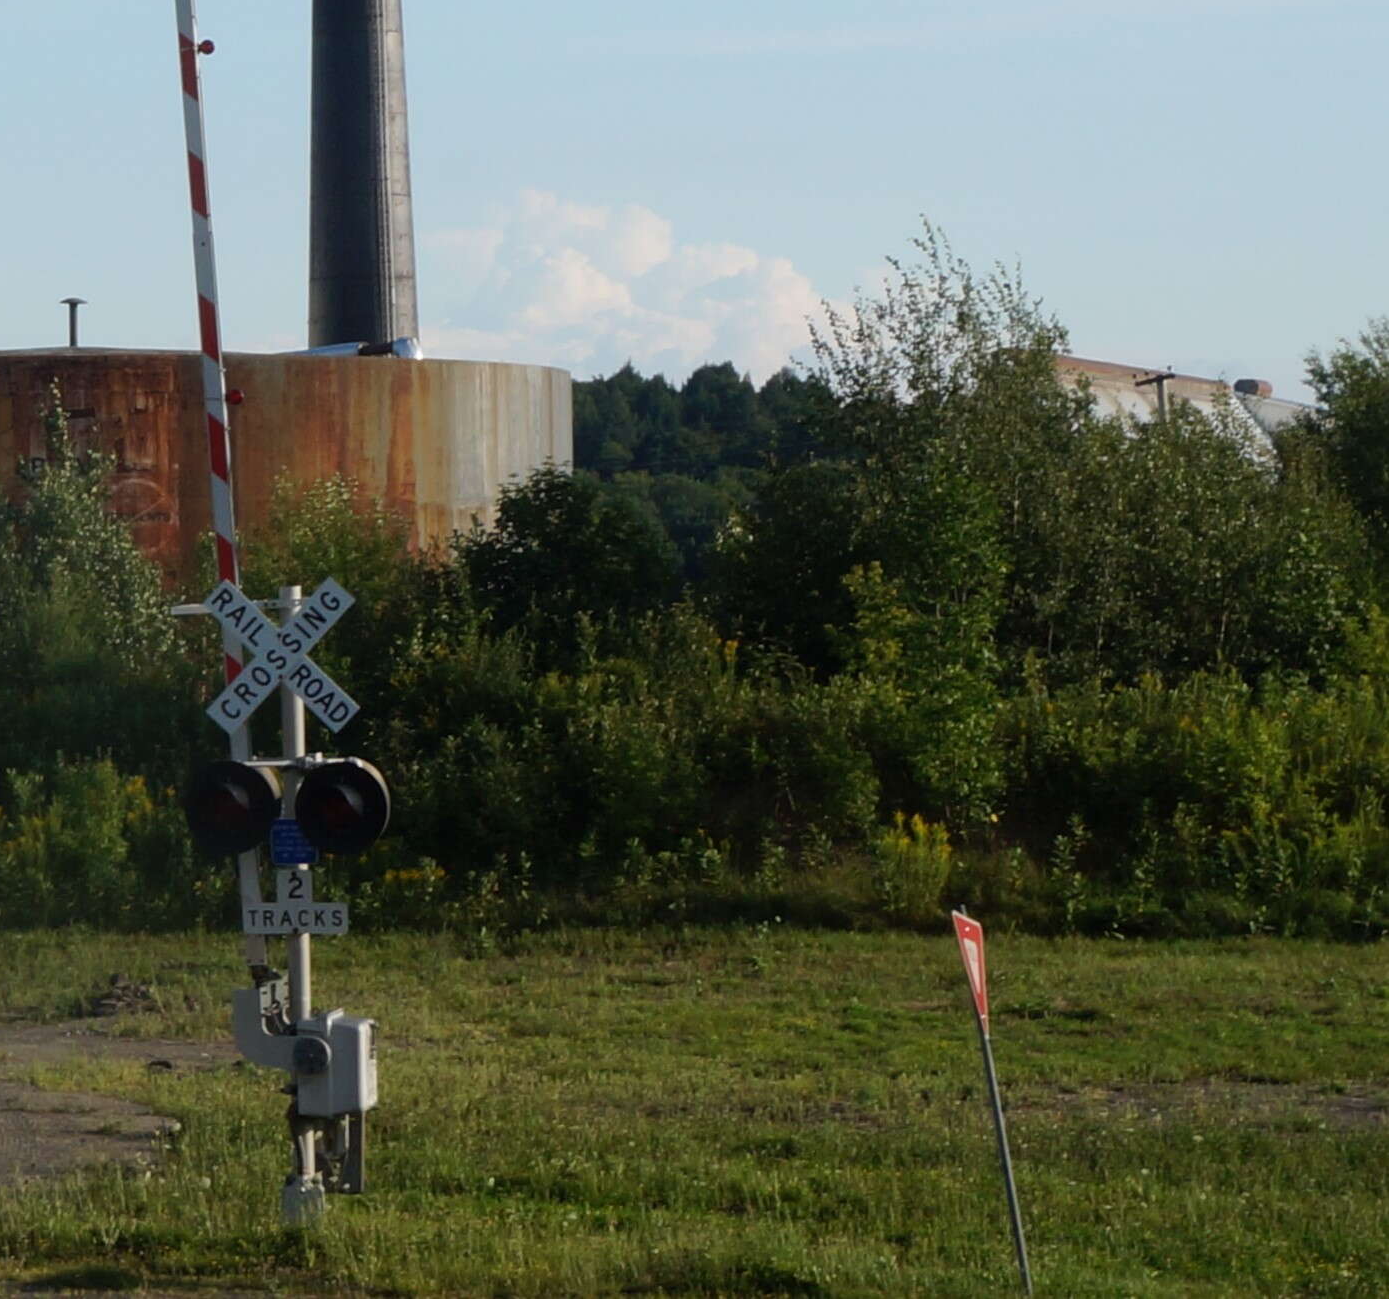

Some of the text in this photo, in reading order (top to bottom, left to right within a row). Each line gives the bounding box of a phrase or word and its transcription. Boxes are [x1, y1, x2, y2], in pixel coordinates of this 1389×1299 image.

[221, 591, 341, 720] CROSSING
[288, 877, 304, 899] 2
[248, 909, 343, 927] TRACKS
